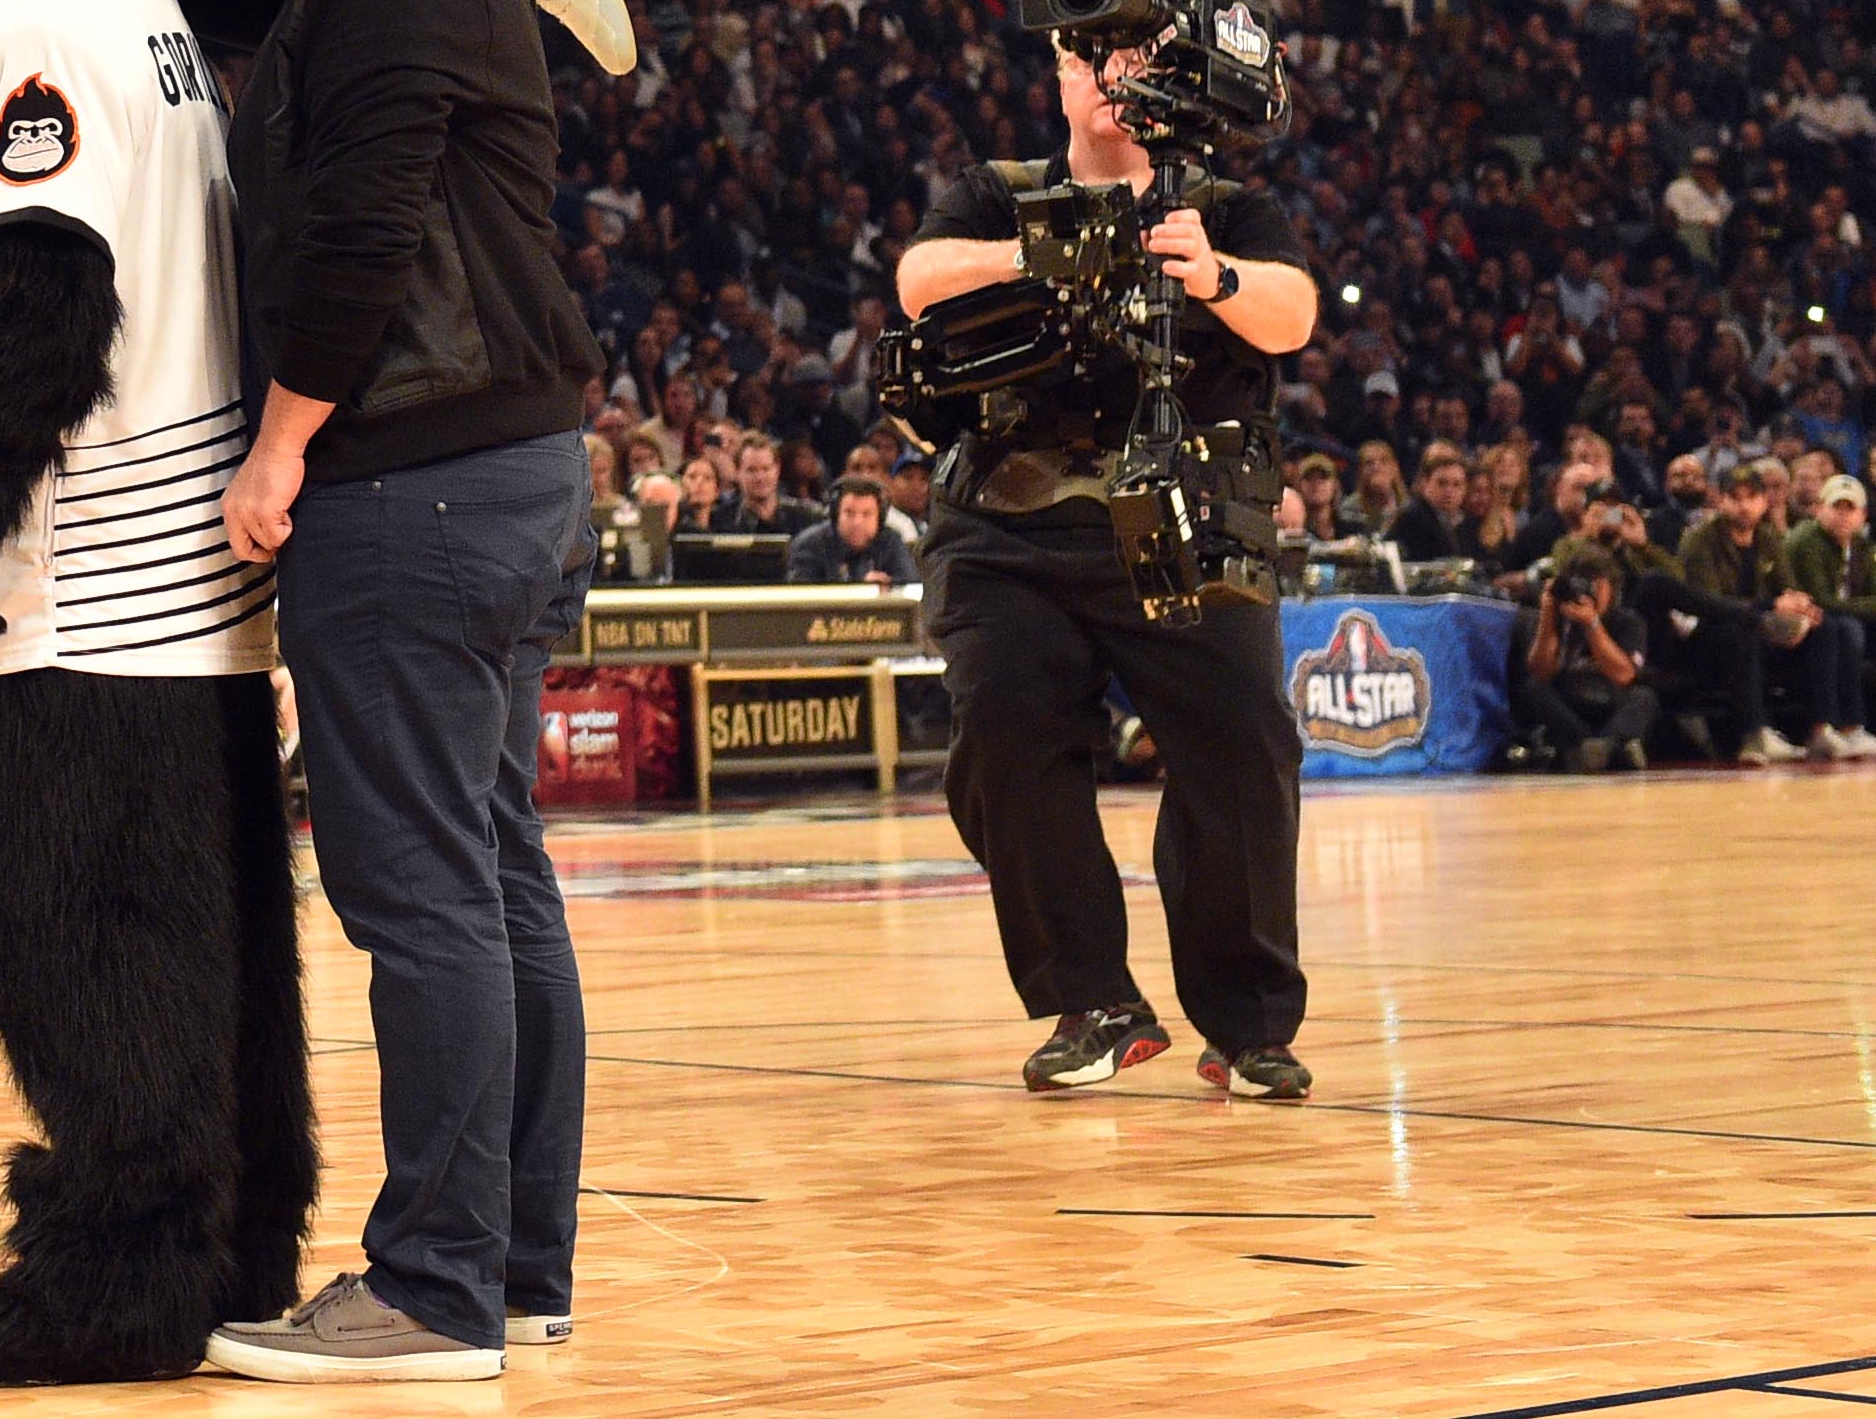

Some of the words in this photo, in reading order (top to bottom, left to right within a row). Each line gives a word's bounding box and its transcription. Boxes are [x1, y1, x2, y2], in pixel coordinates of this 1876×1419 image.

[595, 621, 629, 647] NBA
[634, 621, 658, 647] ON
[662, 619, 692, 646] TNT
[568, 708, 619, 729] verizon
[711, 694, 860, 750] SATURDAY
[569, 727, 620, 756] slam
